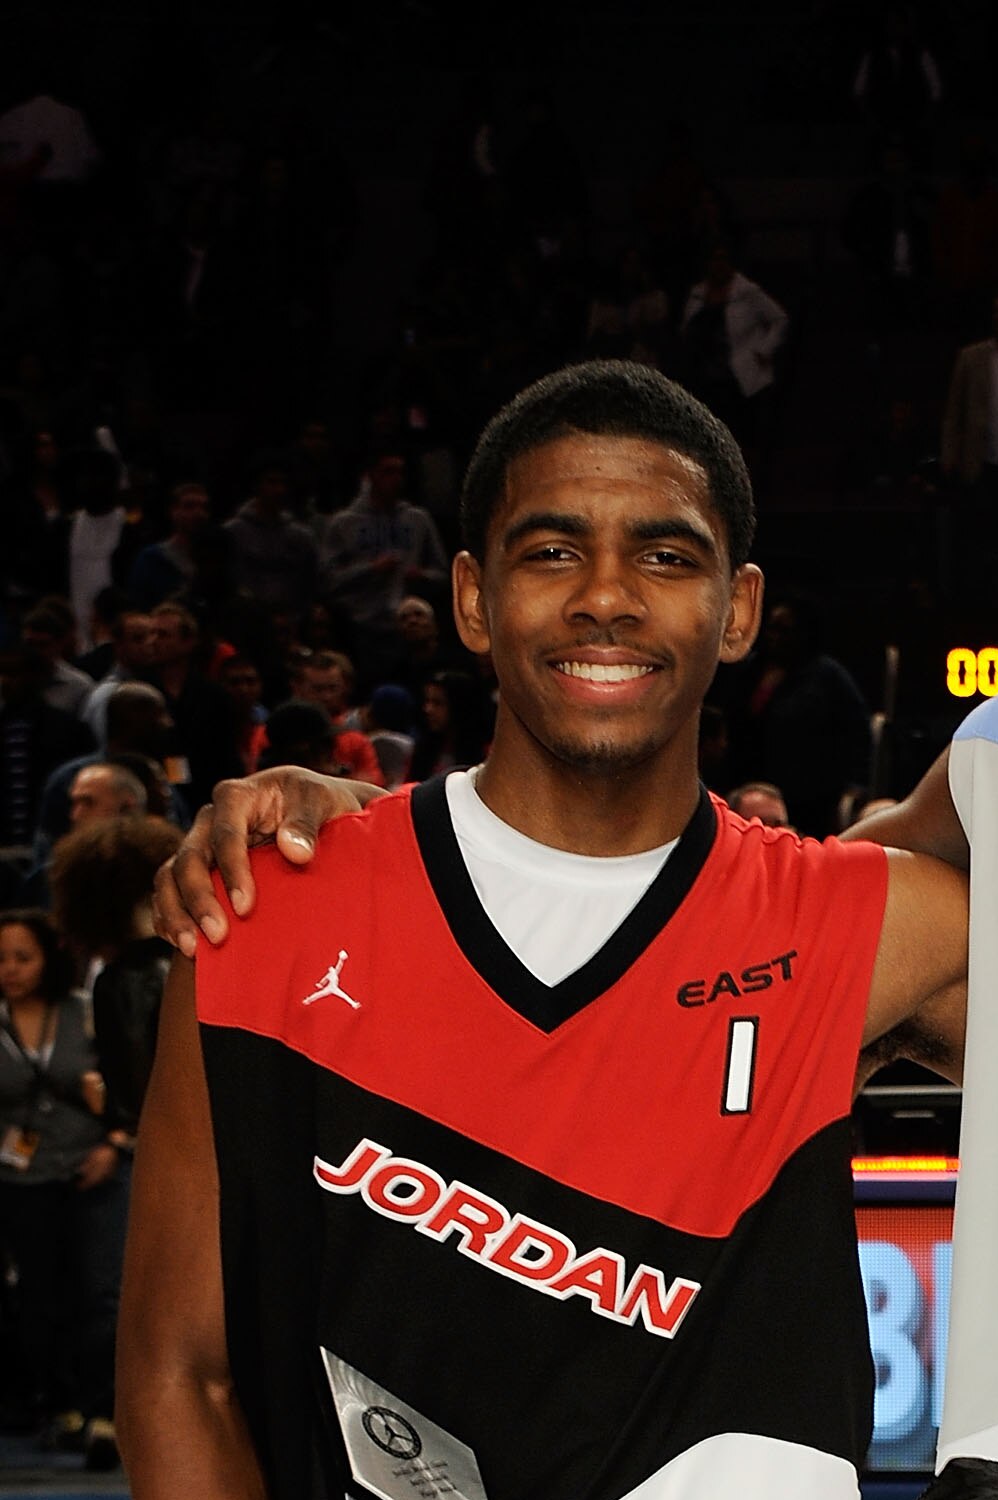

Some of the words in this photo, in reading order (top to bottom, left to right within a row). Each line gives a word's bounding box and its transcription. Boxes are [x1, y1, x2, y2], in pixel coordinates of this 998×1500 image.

[676, 950, 798, 1009] EAST
[720, 1015, 760, 1118] 1
[313, 1138, 702, 1339] JORDAN
